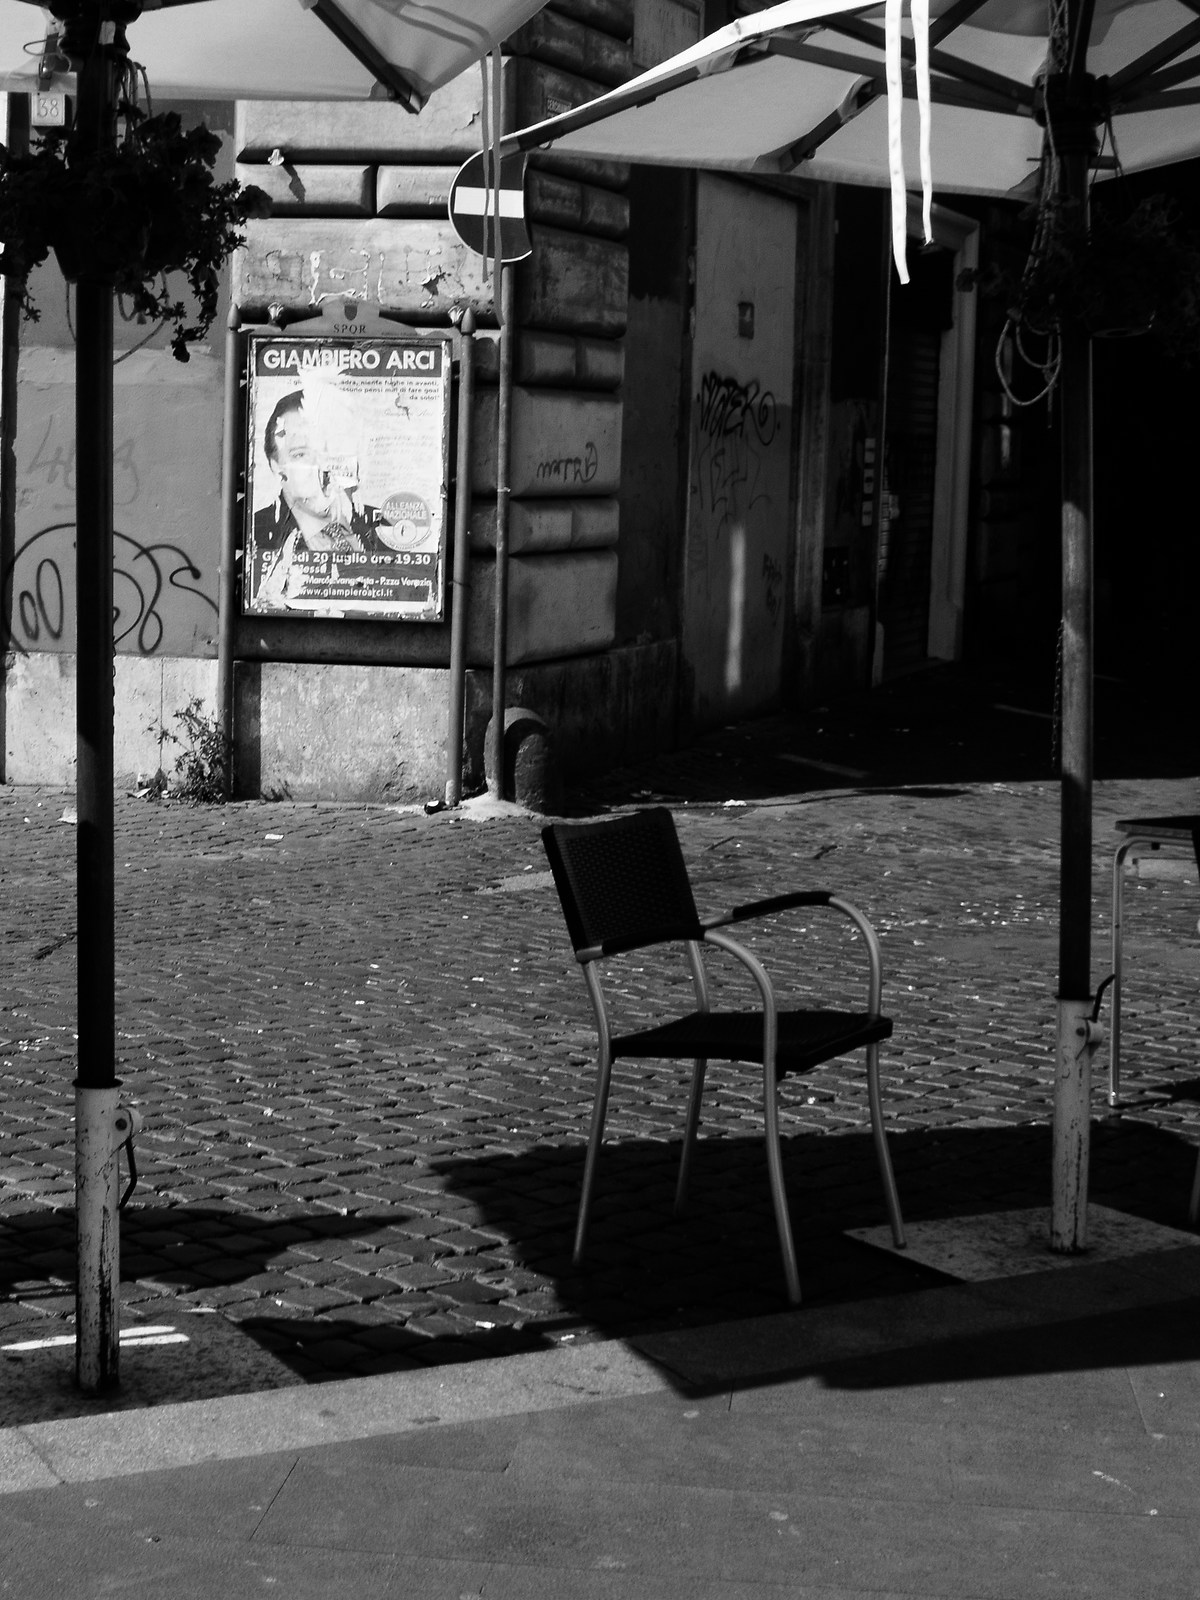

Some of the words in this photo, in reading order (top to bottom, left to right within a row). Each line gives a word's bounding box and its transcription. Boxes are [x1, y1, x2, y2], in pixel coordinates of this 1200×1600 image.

[38, 98, 60, 118] 38
[333, 323, 367, 334] SPQR
[386, 350, 435, 370] ARCI
[262, 551, 310, 562] Giedì
[313, 552, 329, 563] 20
[332, 552, 368, 565] luglio
[395, 553, 432, 565] 19.30
